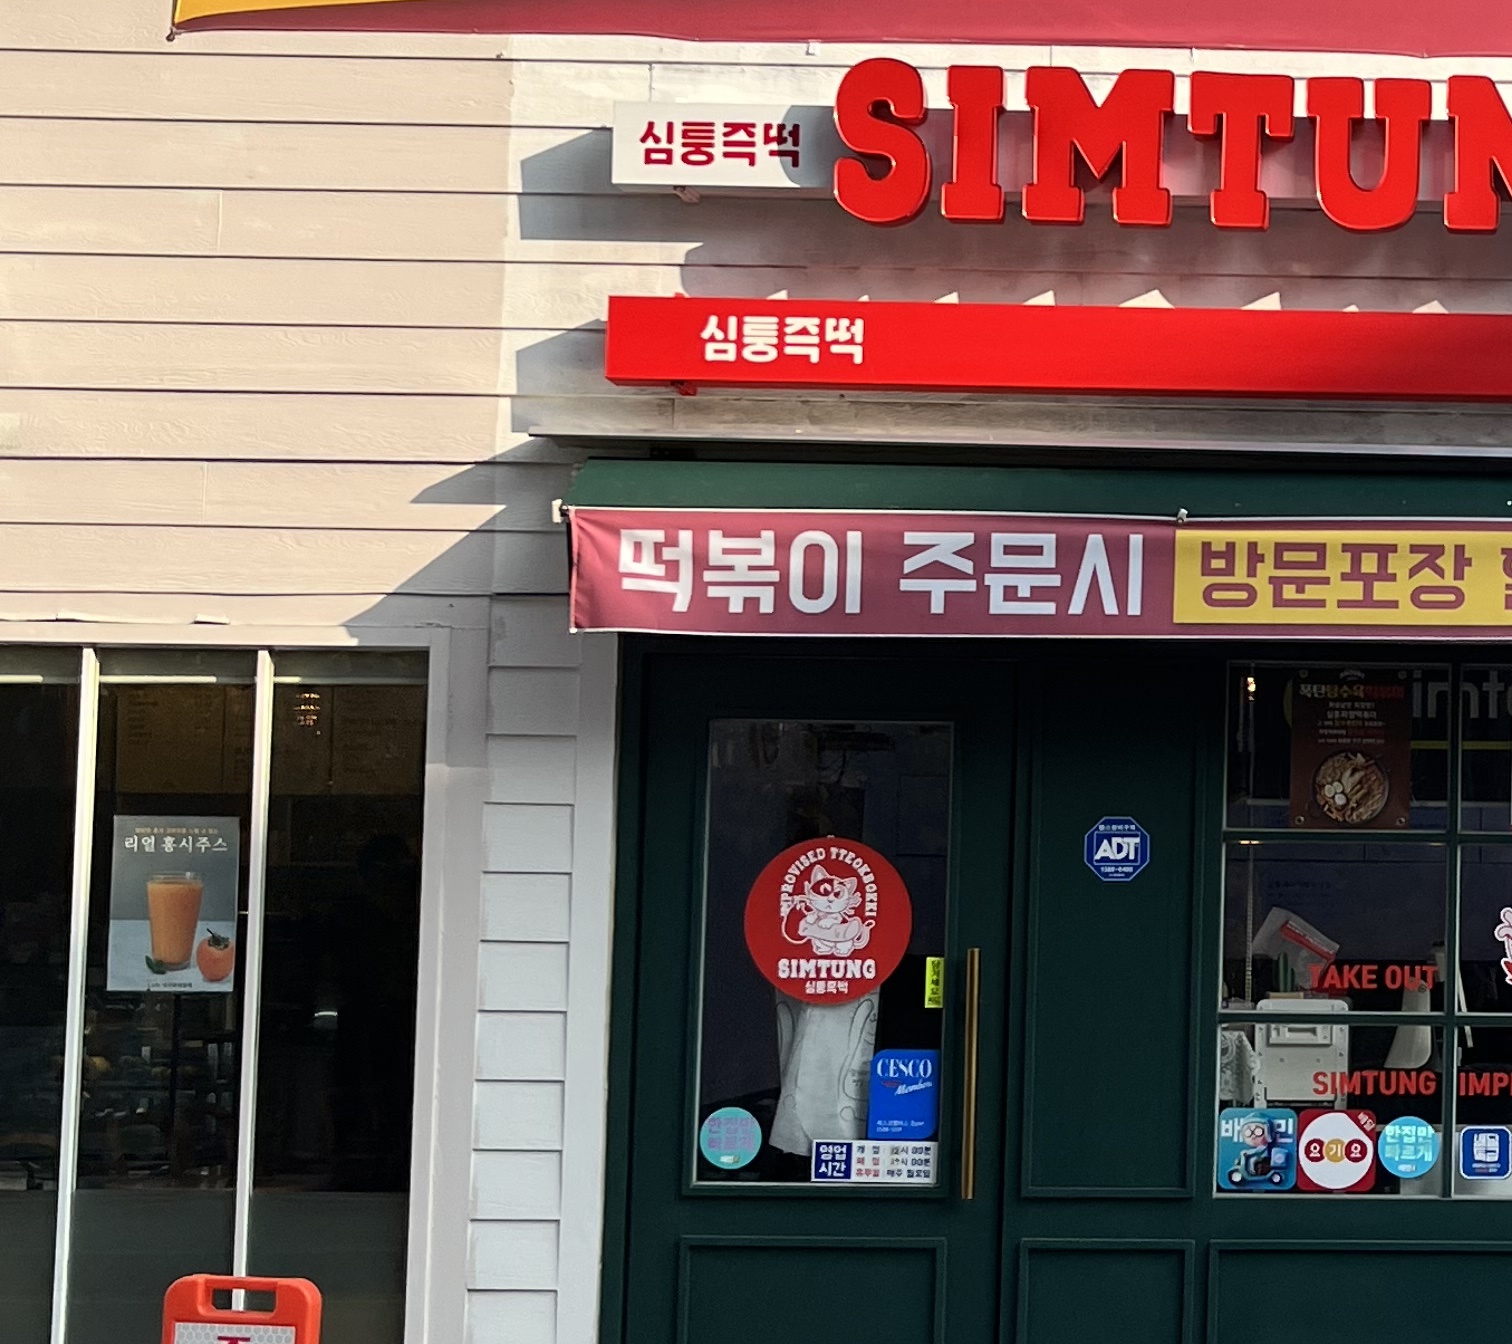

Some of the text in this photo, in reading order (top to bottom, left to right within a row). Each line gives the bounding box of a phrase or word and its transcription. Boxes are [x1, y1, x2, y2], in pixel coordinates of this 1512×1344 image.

[640, 121, 800, 168] 심퉁즉떡
[700, 315, 864, 364] 심퉁즉떡
[618, 528, 862, 614] 떡볶이
[899, 531, 1143, 616] 주문시
[1200, 540, 1473, 610] 방문포장
[124, 834, 228, 853] 리얼 홍시주스
[1094, 837, 1140, 860] ADT
[777, 958, 876, 979] SIMTUNG
[1308, 964, 1438, 991] TAKE OUT
[876, 1058, 932, 1078] CESCO
[1312, 1070, 1437, 1097] SIMTUNG
[819, 1144, 847, 1161] 영업
[1309, 1142, 1363, 1158] 요기요
[819, 1161, 847, 1177] 시간
